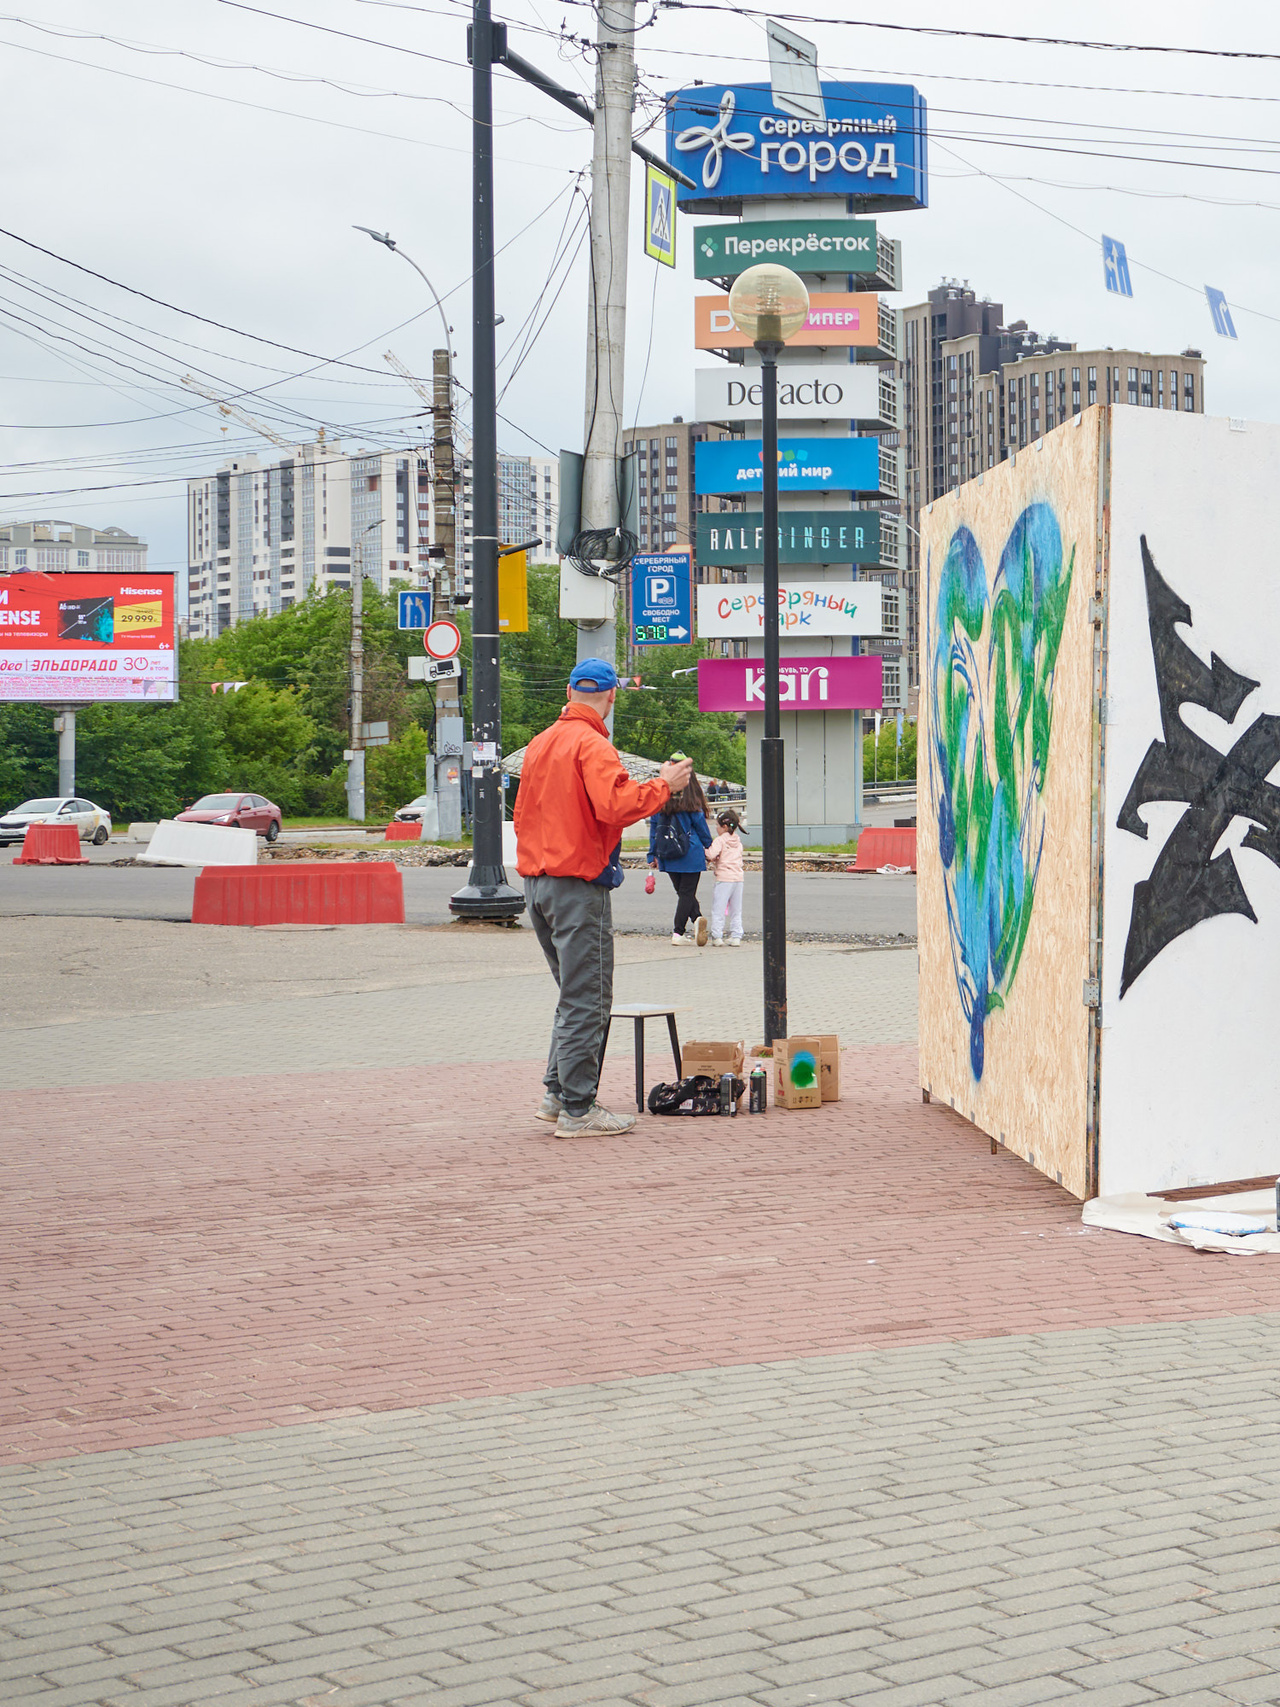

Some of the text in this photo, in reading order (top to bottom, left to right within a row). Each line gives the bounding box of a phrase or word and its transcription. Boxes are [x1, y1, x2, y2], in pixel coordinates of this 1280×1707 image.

[760, 140, 898, 183] город
[724, 233, 871, 258] Перекрёсток
[808, 312, 854, 326] ИПЕР
[727, 379, 844, 406] Deacto
[736, 463, 833, 481] детий мир
[647, 565, 674, 573] ГОРОД
[120, 587, 163, 595] Hisense
[158, 642, 170, 650] 6+
[31, 659, 118, 671] ЭЛЬДОРАДО
[745, 666, 829, 702] kari
